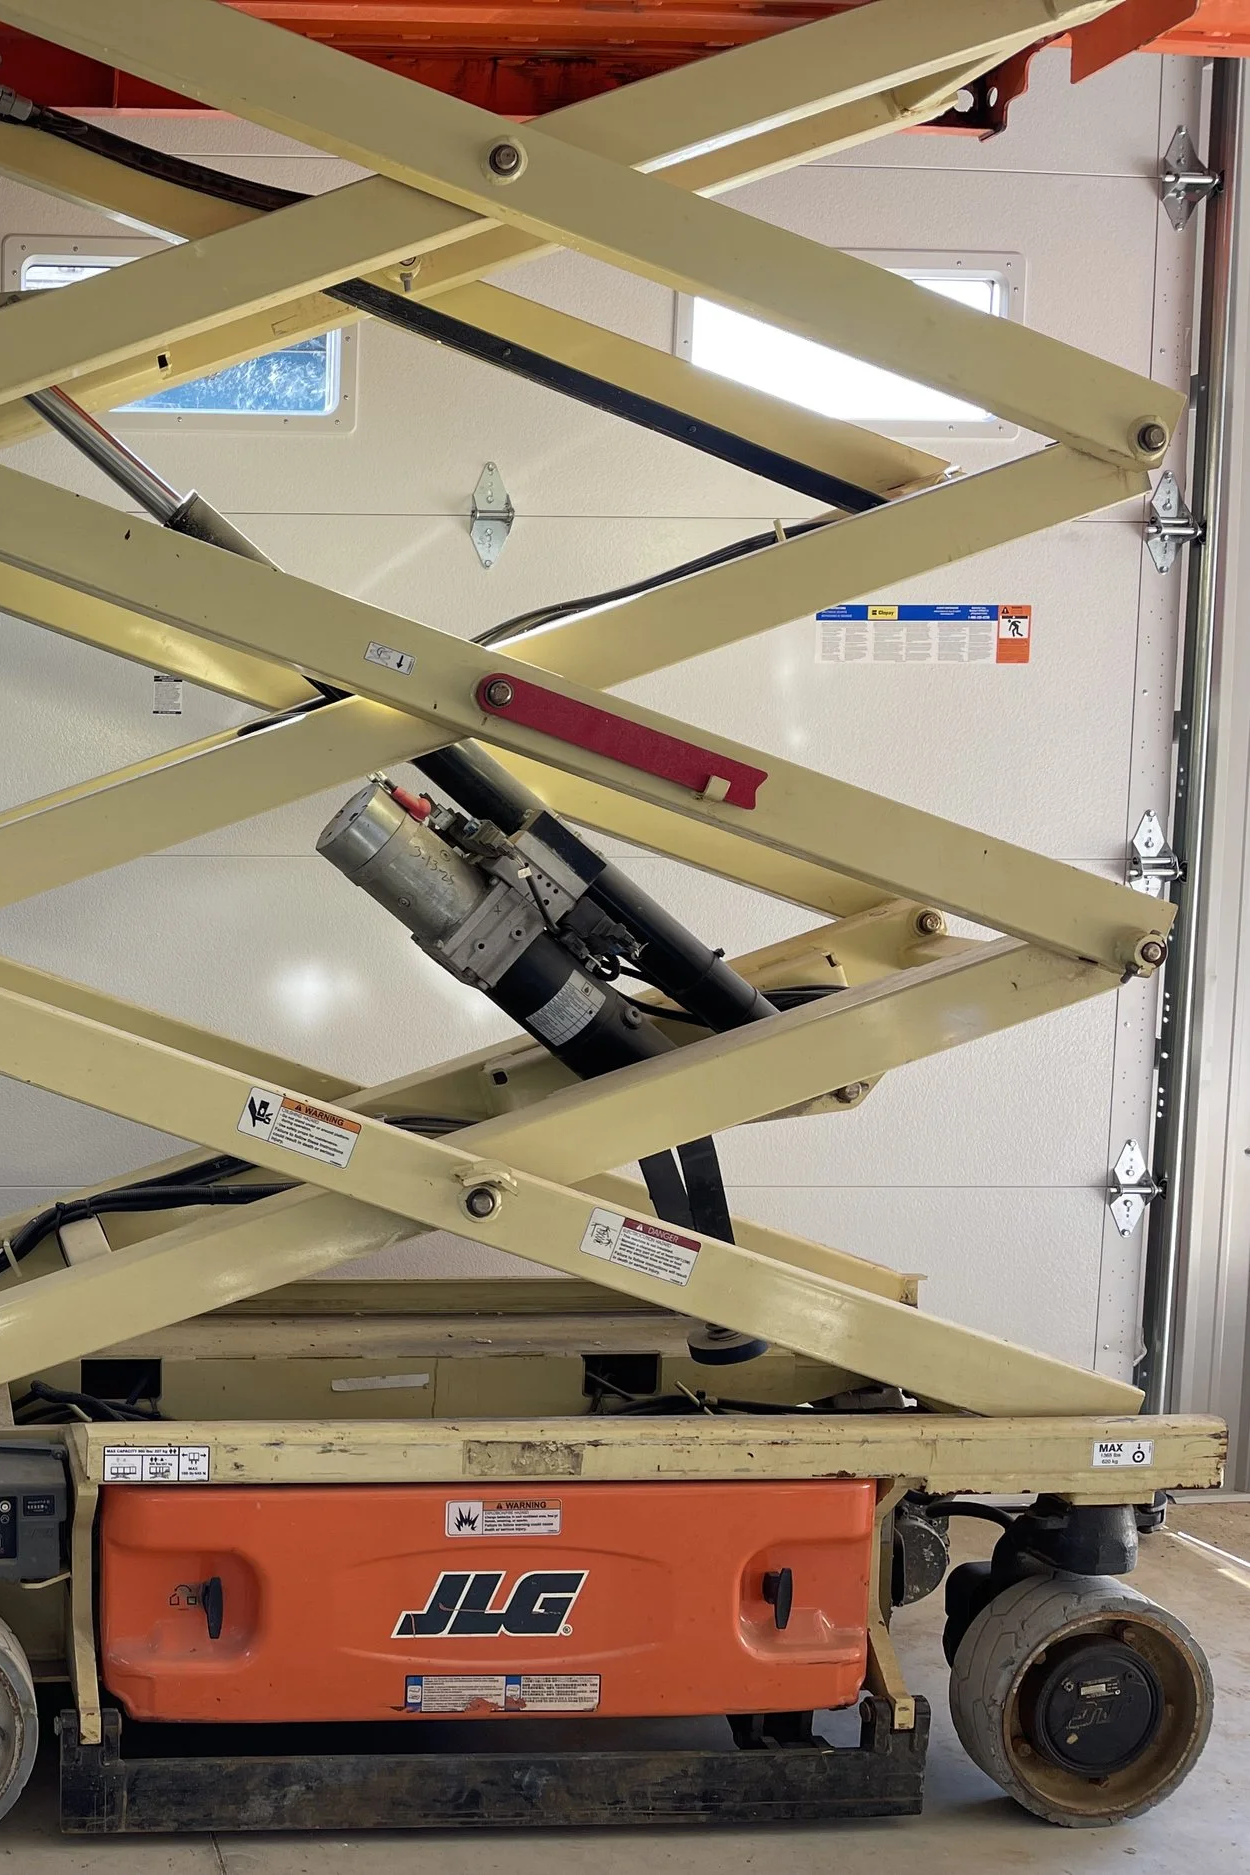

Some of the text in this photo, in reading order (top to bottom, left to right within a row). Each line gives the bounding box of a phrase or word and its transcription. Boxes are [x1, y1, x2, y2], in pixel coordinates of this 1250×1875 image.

[304, 1107, 344, 1126] WARNING
[647, 1227, 679, 1243] DANGER
[1099, 1444, 1123, 1452] MAX
[391, 1570, 590, 1638] JLG
